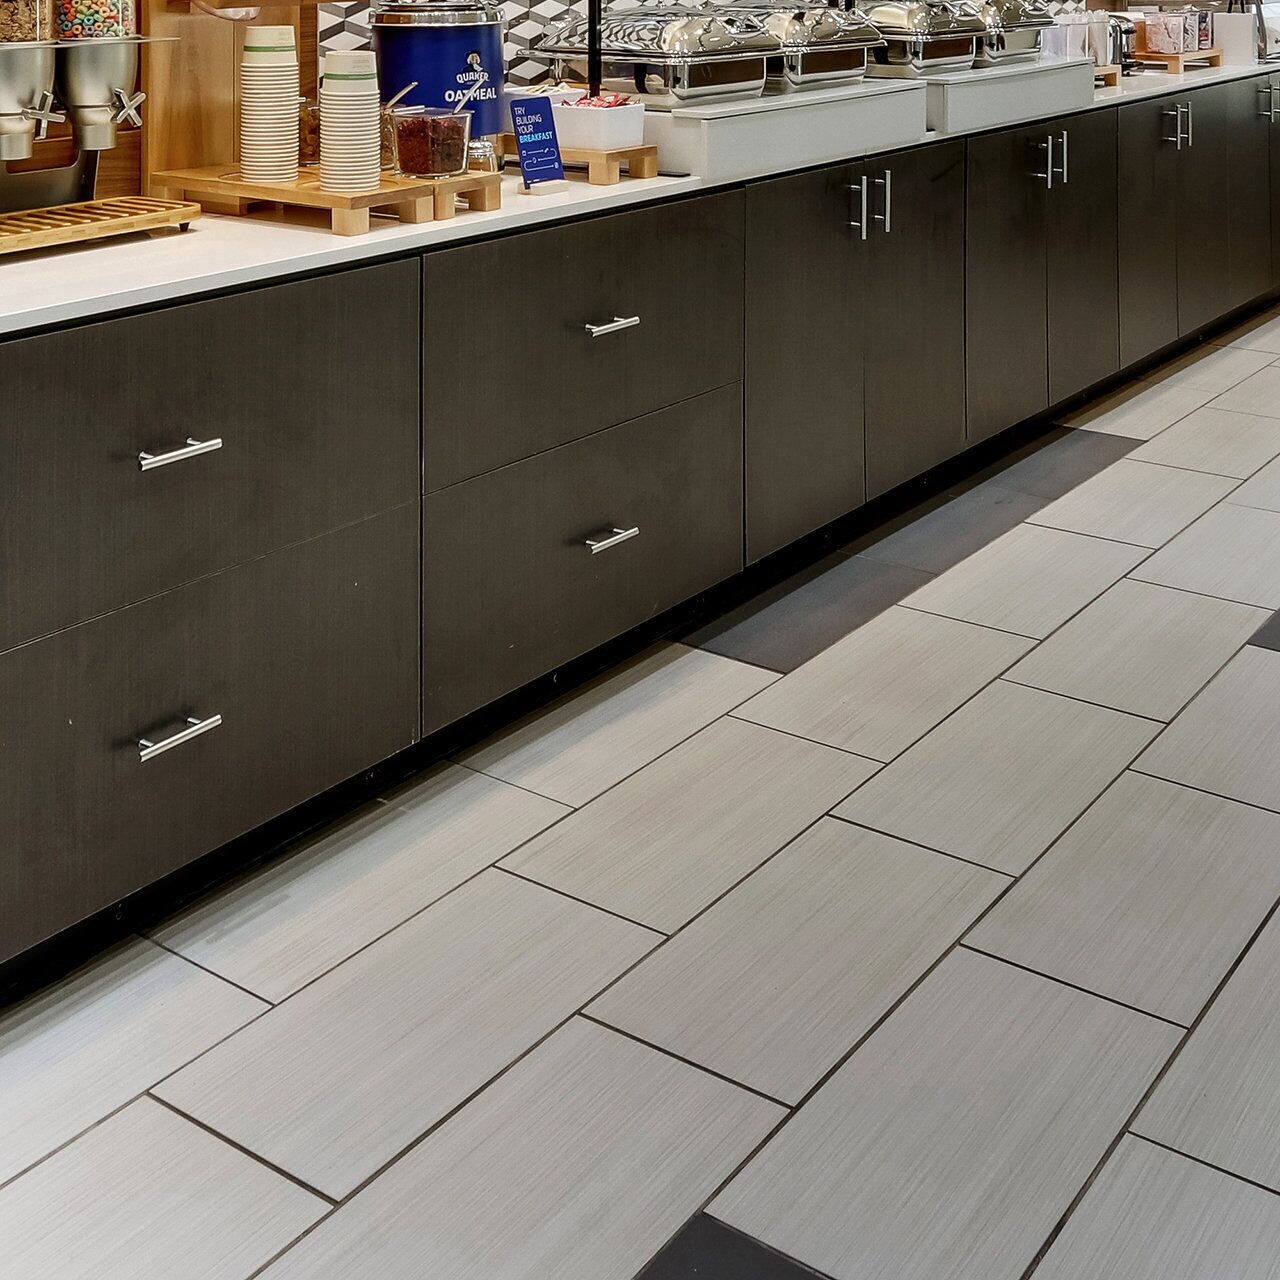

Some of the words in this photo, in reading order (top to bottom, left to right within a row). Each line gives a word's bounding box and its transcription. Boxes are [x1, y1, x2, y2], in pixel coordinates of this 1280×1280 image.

[456, 72, 490, 84] QUAKER
[514, 107, 526, 115] TRY
[516, 114, 542, 125] BUILDING
[517, 124, 534, 134] YOUR
[520, 131, 553, 144] BREAKFAST
